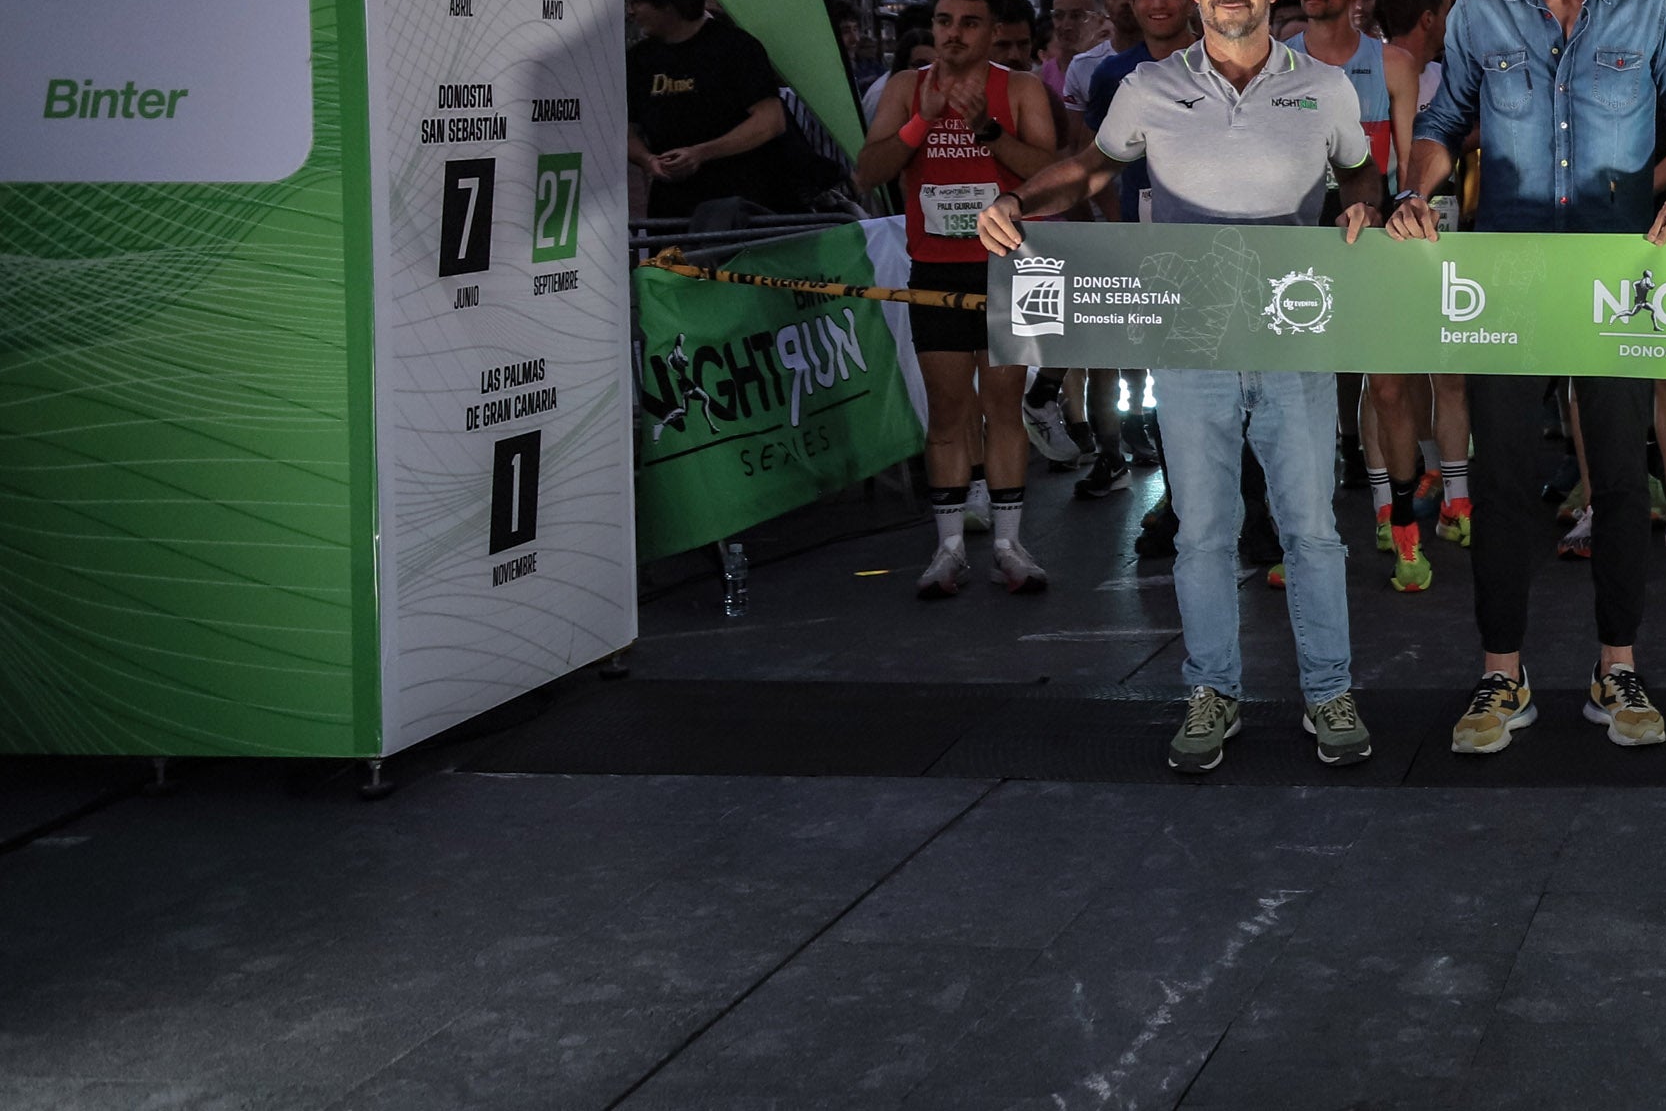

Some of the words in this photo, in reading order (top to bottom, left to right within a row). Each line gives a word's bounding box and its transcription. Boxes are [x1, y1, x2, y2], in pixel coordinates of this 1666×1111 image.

[542, 0, 563, 21] MAYO
[43, 78, 188, 120] Binter
[438, 84, 493, 111] DONOSTIA
[532, 98, 581, 123] ZARAGOZA
[421, 119, 444, 144] SAN
[449, 112, 507, 143] SEBASTIÁN
[927, 133, 975, 145] GENEV
[927, 146, 991, 159] MARATHO
[457, 177, 480, 260] 7
[536, 170, 579, 250] 27
[943, 214, 977, 230] 1355
[533, 270, 579, 297] SEPTIEMBRE
[1073, 276, 1142, 289] DONOSTIA
[454, 285, 480, 310] JUNIO
[1073, 292, 1101, 305] SAN
[1103, 289, 1181, 305] SEBASTIÁN
[1074, 312, 1126, 325] Donostia
[1128, 313, 1163, 325] Kirola
[1441, 326, 1518, 345] berabera
[481, 367, 500, 395] LAS
[504, 359, 546, 390] PALMAS
[466, 407, 481, 432] DE
[483, 398, 511, 429] GRAN
[514, 387, 558, 424] CANARIA
[510, 453, 521, 534] 1
[492, 552, 537, 588] NOVIEMBRE
